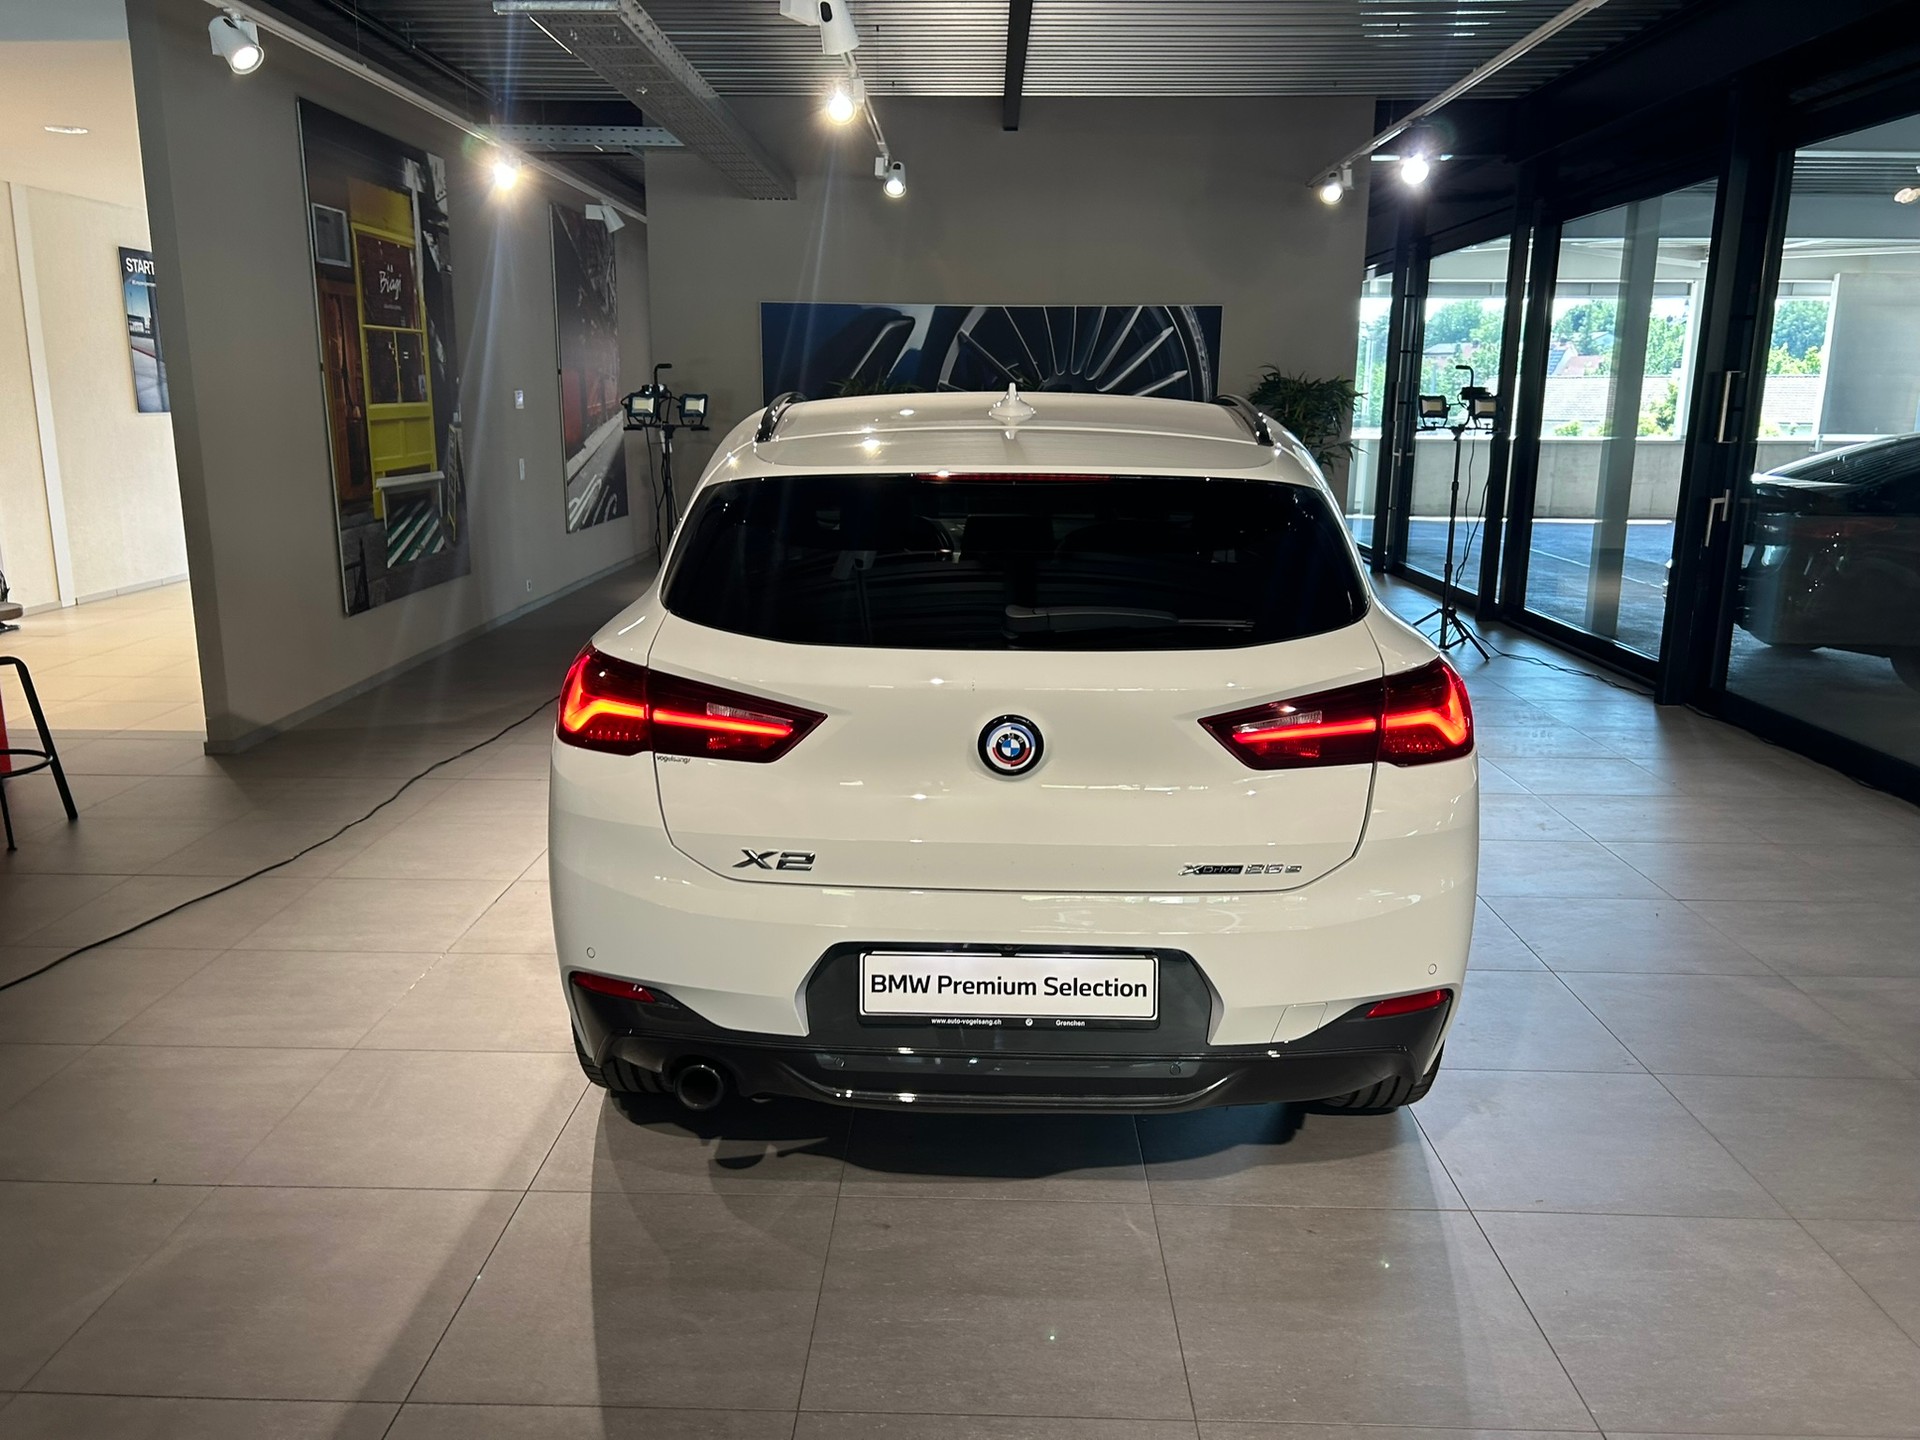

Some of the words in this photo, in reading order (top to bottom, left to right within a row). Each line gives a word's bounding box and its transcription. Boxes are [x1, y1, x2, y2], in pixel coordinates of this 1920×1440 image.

[125, 257, 155, 276] START
[732, 848, 816, 872] X2
[871, 974, 931, 994] BMW
[937, 976, 1037, 996] Premium
[1043, 976, 1147, 998] Selection
[931, 1017, 1002, 1026] www.auto-vogelsang.ch
